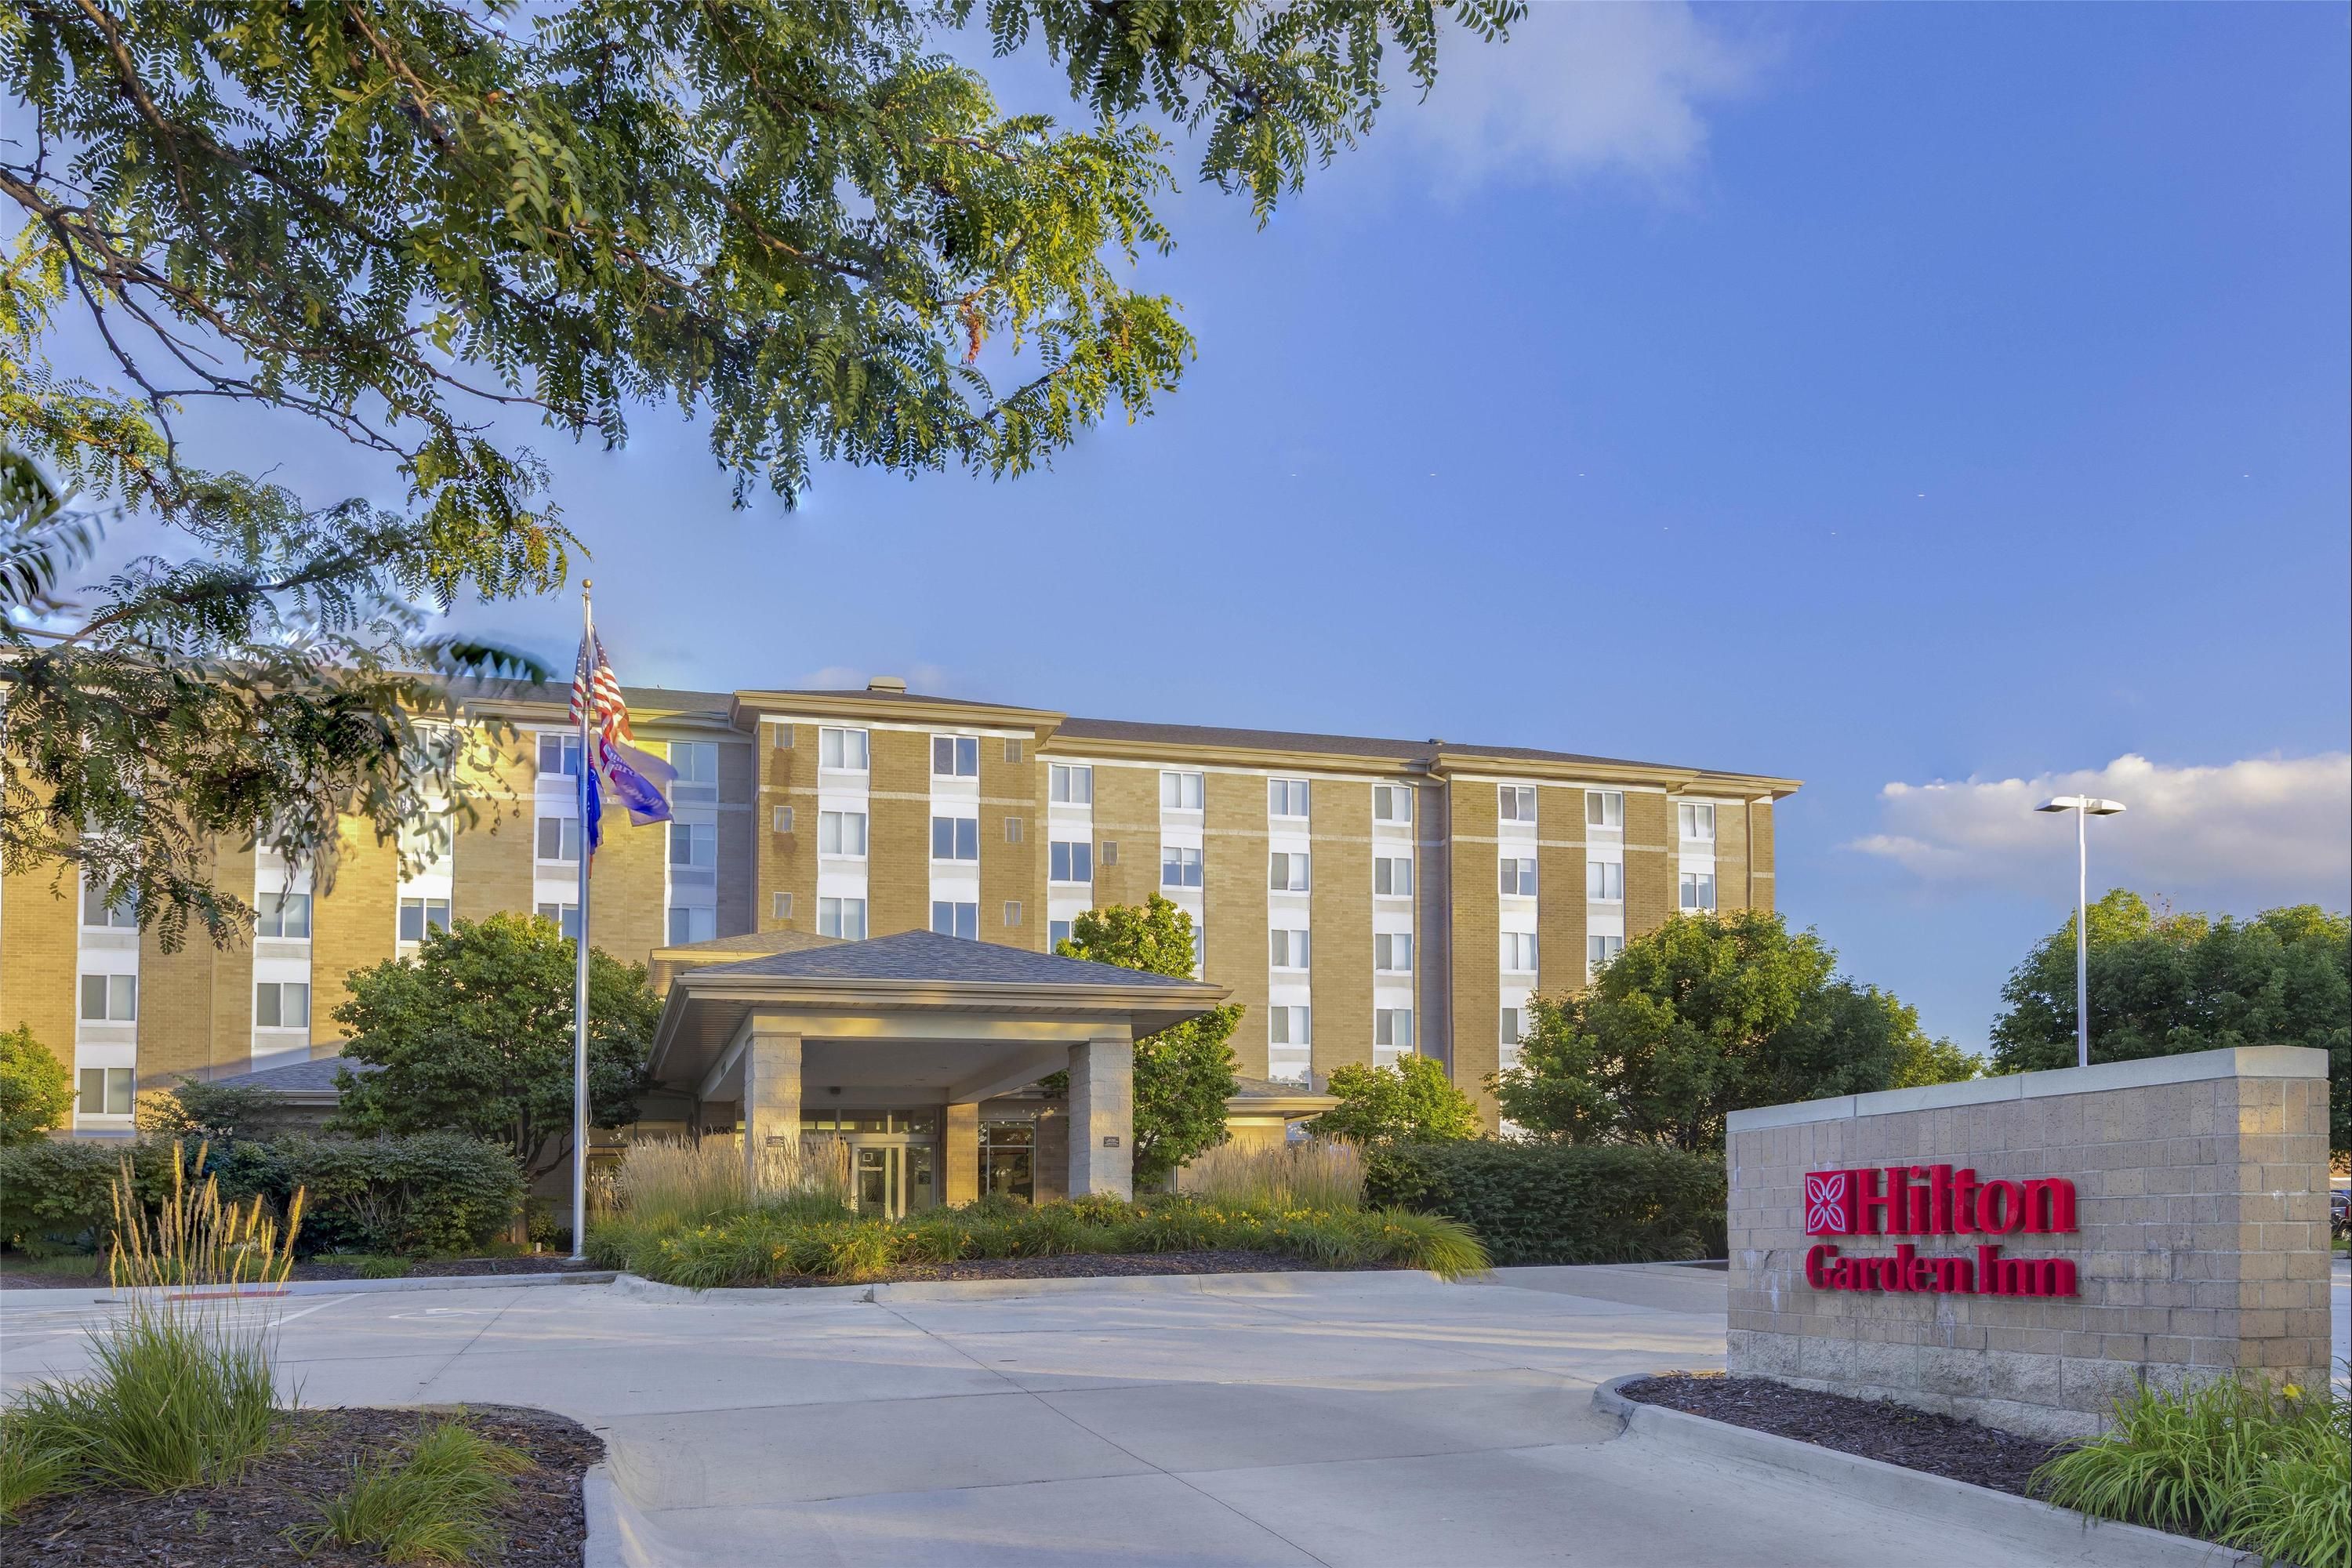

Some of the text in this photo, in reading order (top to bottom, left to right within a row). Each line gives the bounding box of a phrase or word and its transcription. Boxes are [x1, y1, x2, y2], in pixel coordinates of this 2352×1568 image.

[1855, 1164, 2079, 1236] Hilton
[1806, 1244, 2081, 1297] Garden Inn
